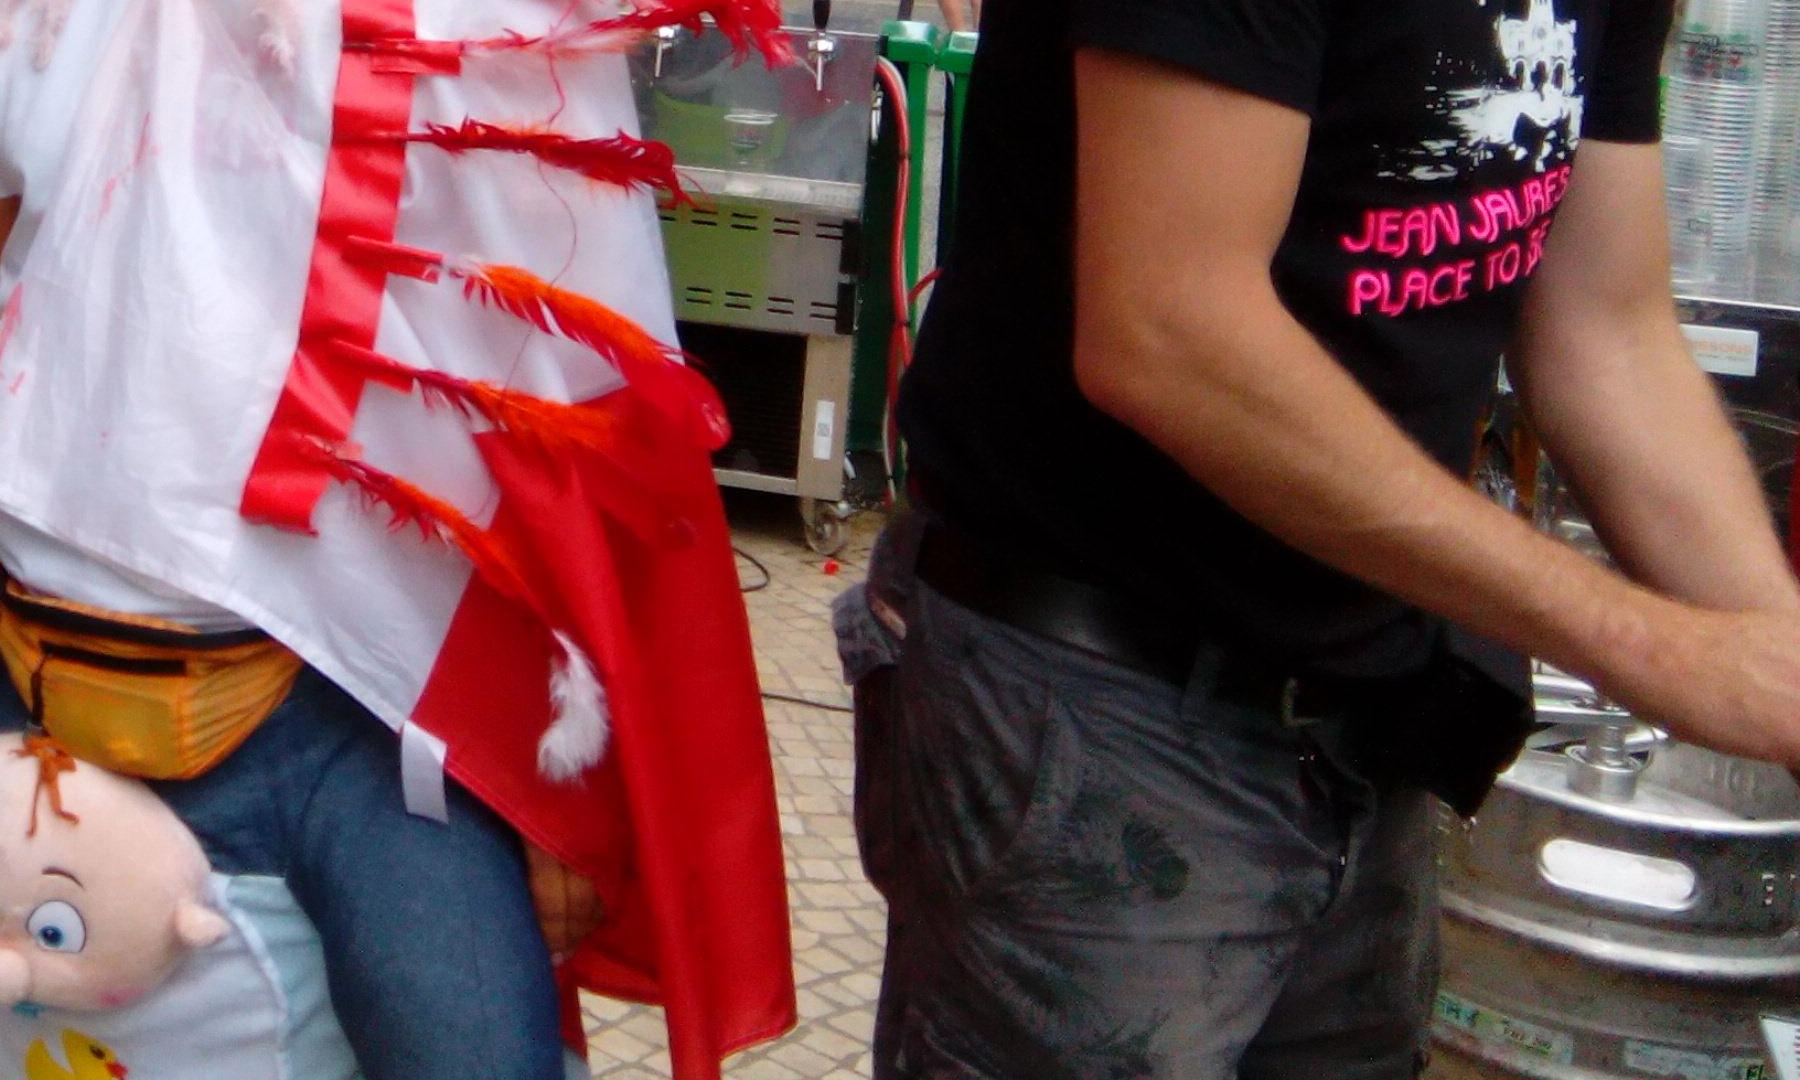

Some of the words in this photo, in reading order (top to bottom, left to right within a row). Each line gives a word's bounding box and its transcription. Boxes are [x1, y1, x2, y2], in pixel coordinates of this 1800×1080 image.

[1340, 202, 1461, 258] JEAN
[1470, 163, 1573, 245] JAURES
[1347, 258, 1476, 318] PLACE
[1485, 243, 1522, 293] TO
